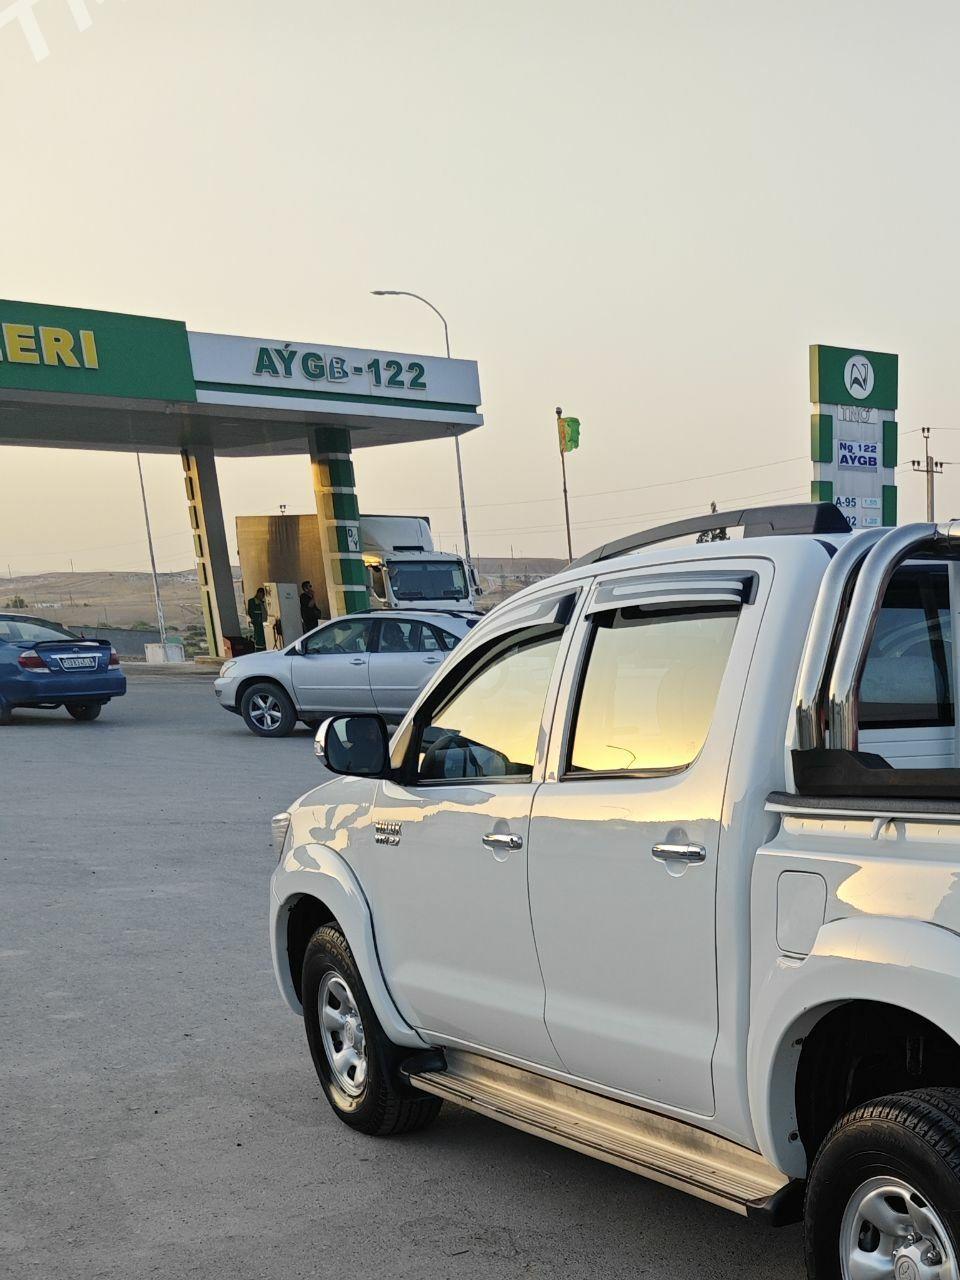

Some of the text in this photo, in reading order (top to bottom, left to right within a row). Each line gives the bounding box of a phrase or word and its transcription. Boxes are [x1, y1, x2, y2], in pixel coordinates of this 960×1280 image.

[0, 323, 98, 370] ERI
[858, 444, 877, 453] 122
[836, 497, 856, 507] A-95
